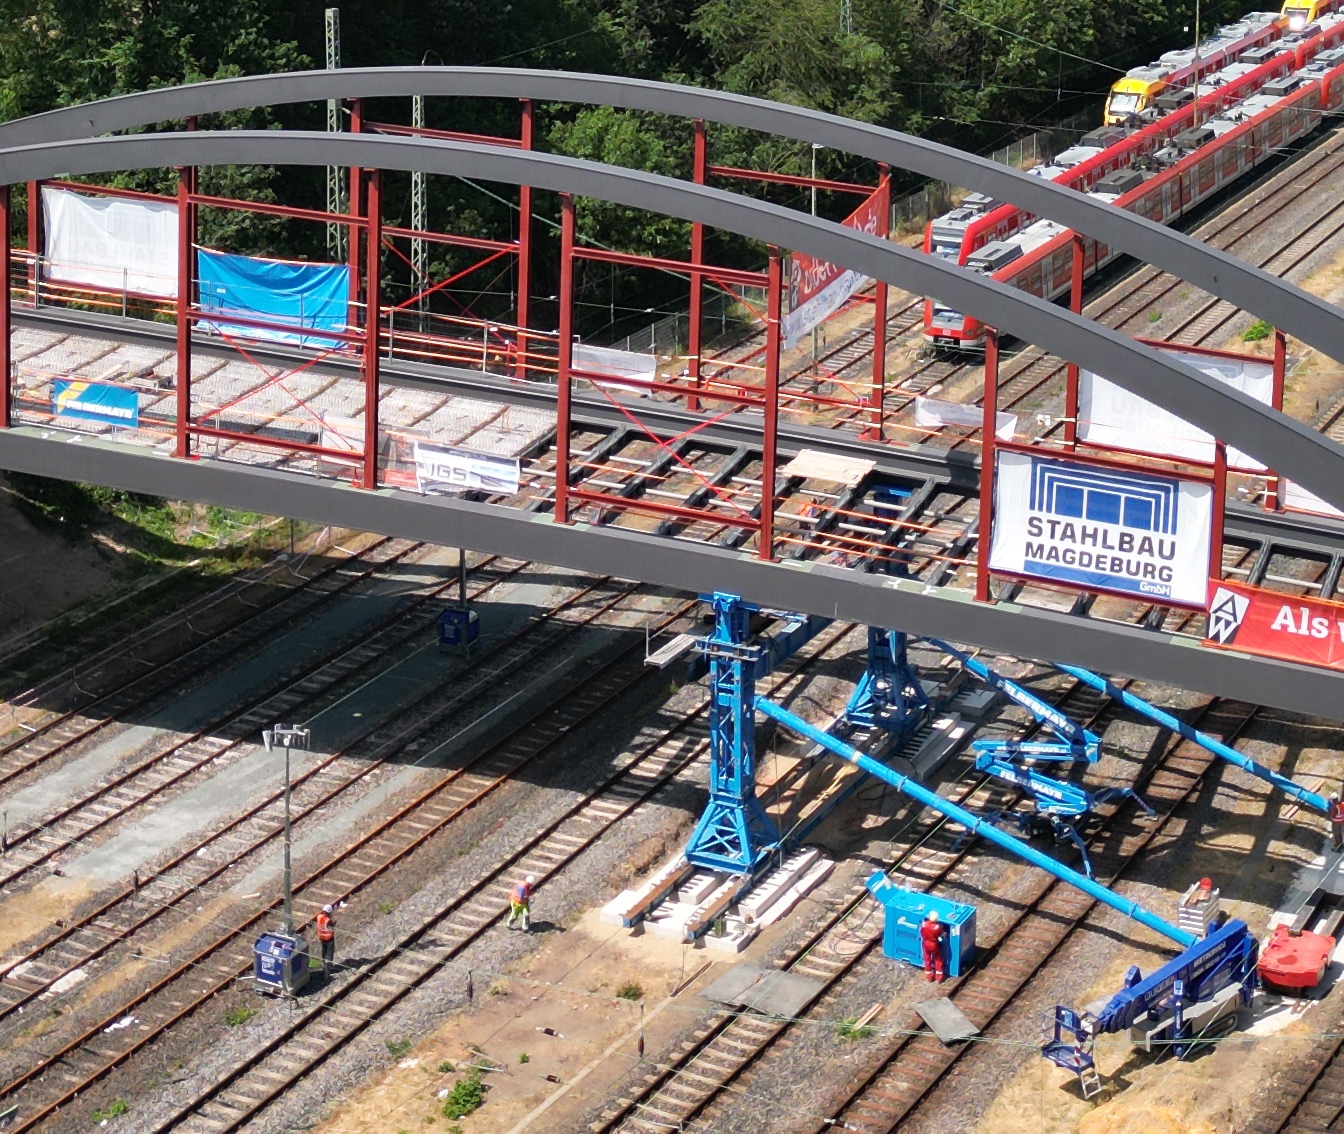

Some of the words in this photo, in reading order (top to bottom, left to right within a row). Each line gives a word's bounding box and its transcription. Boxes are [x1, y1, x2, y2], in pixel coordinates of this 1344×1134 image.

[431, 462, 467, 481] IGS
[1027, 516, 1176, 561] STAHLBAU
[1024, 541, 1174, 583] MAGDEBURG
[1139, 581, 1171, 596] GmbH
[1270, 605, 1330, 639] Als
